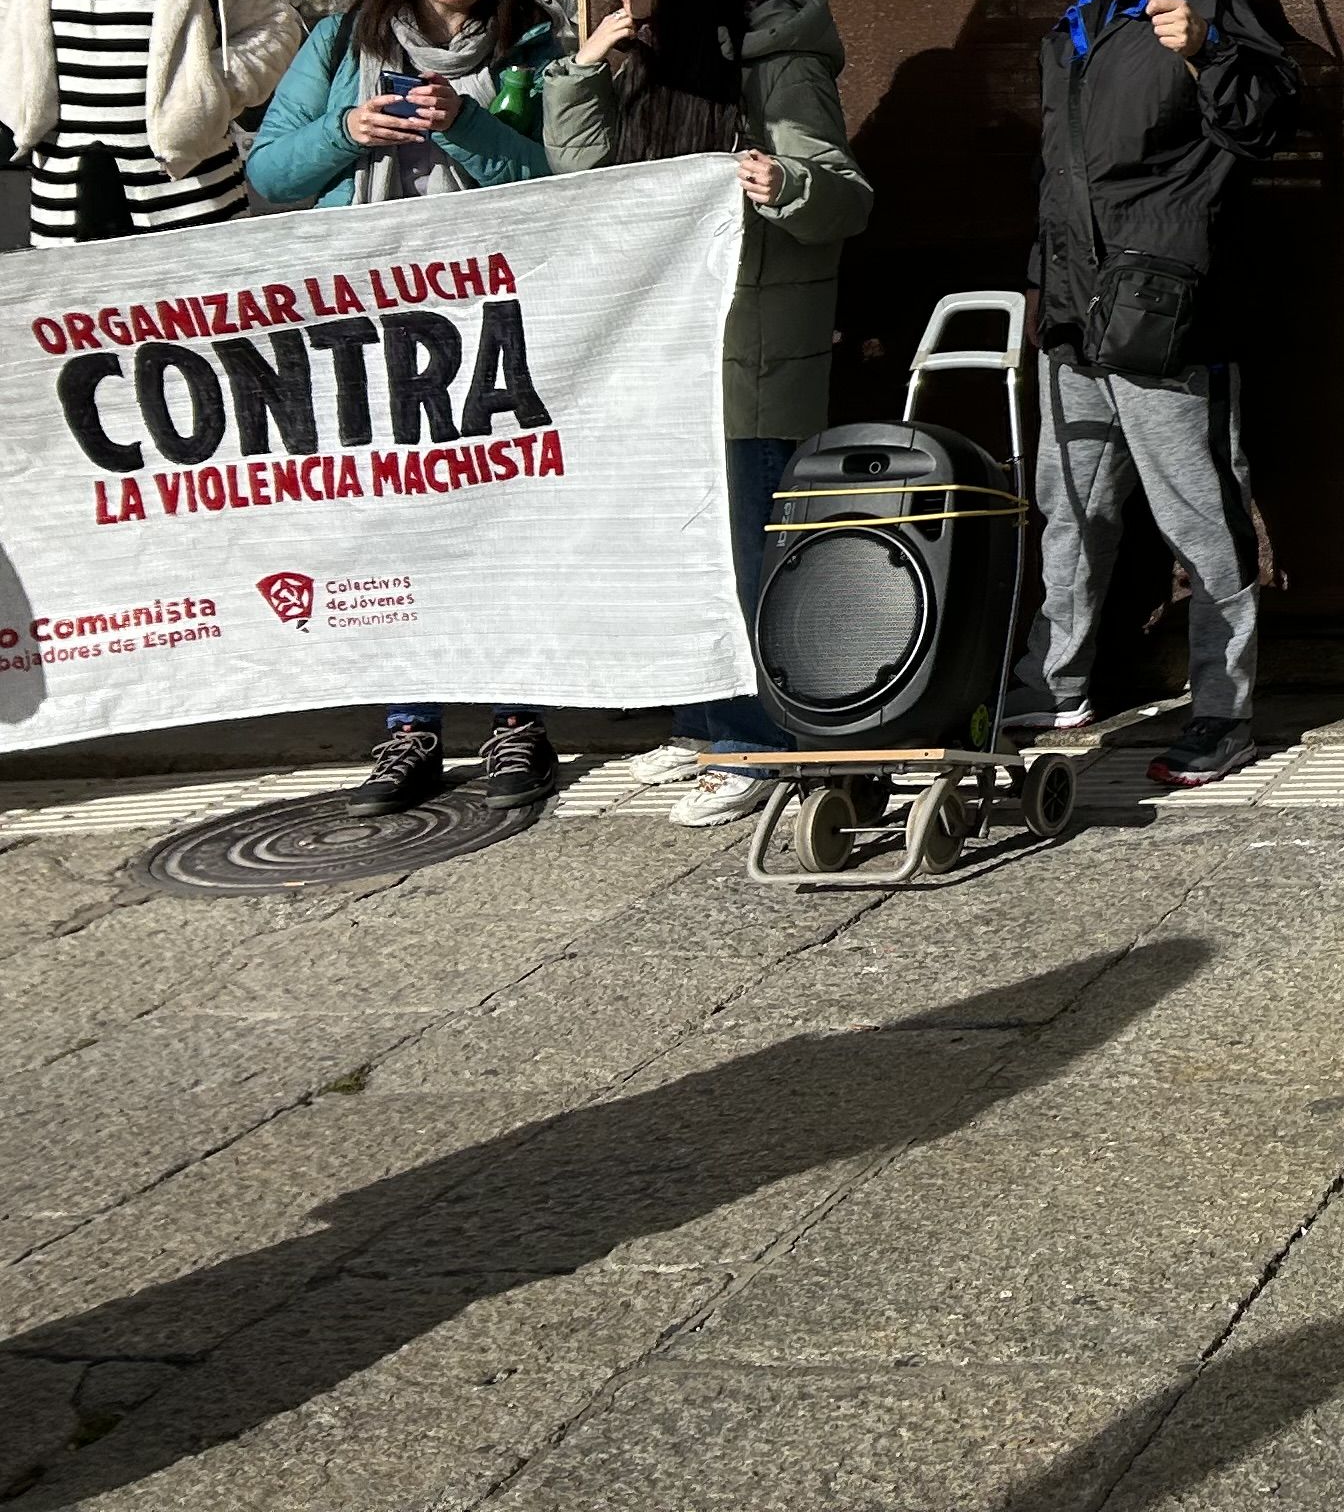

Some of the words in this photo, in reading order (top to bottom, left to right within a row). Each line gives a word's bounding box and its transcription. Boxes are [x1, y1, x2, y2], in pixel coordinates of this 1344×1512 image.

[32, 285, 305, 355] ORGANIZAR
[314, 274, 367, 319] LA
[370, 253, 518, 306] LUCHA
[53, 297, 555, 475] CONTRA
[96, 478, 145, 524] LA
[155, 456, 362, 515] VIOLENCIA
[371, 430, 563, 496] MACHISTA
[29, 596, 217, 642] Comunista
[108, 637, 136, 655] de
[143, 623, 221, 649] España
[327, 611, 418, 628] Comunistas
